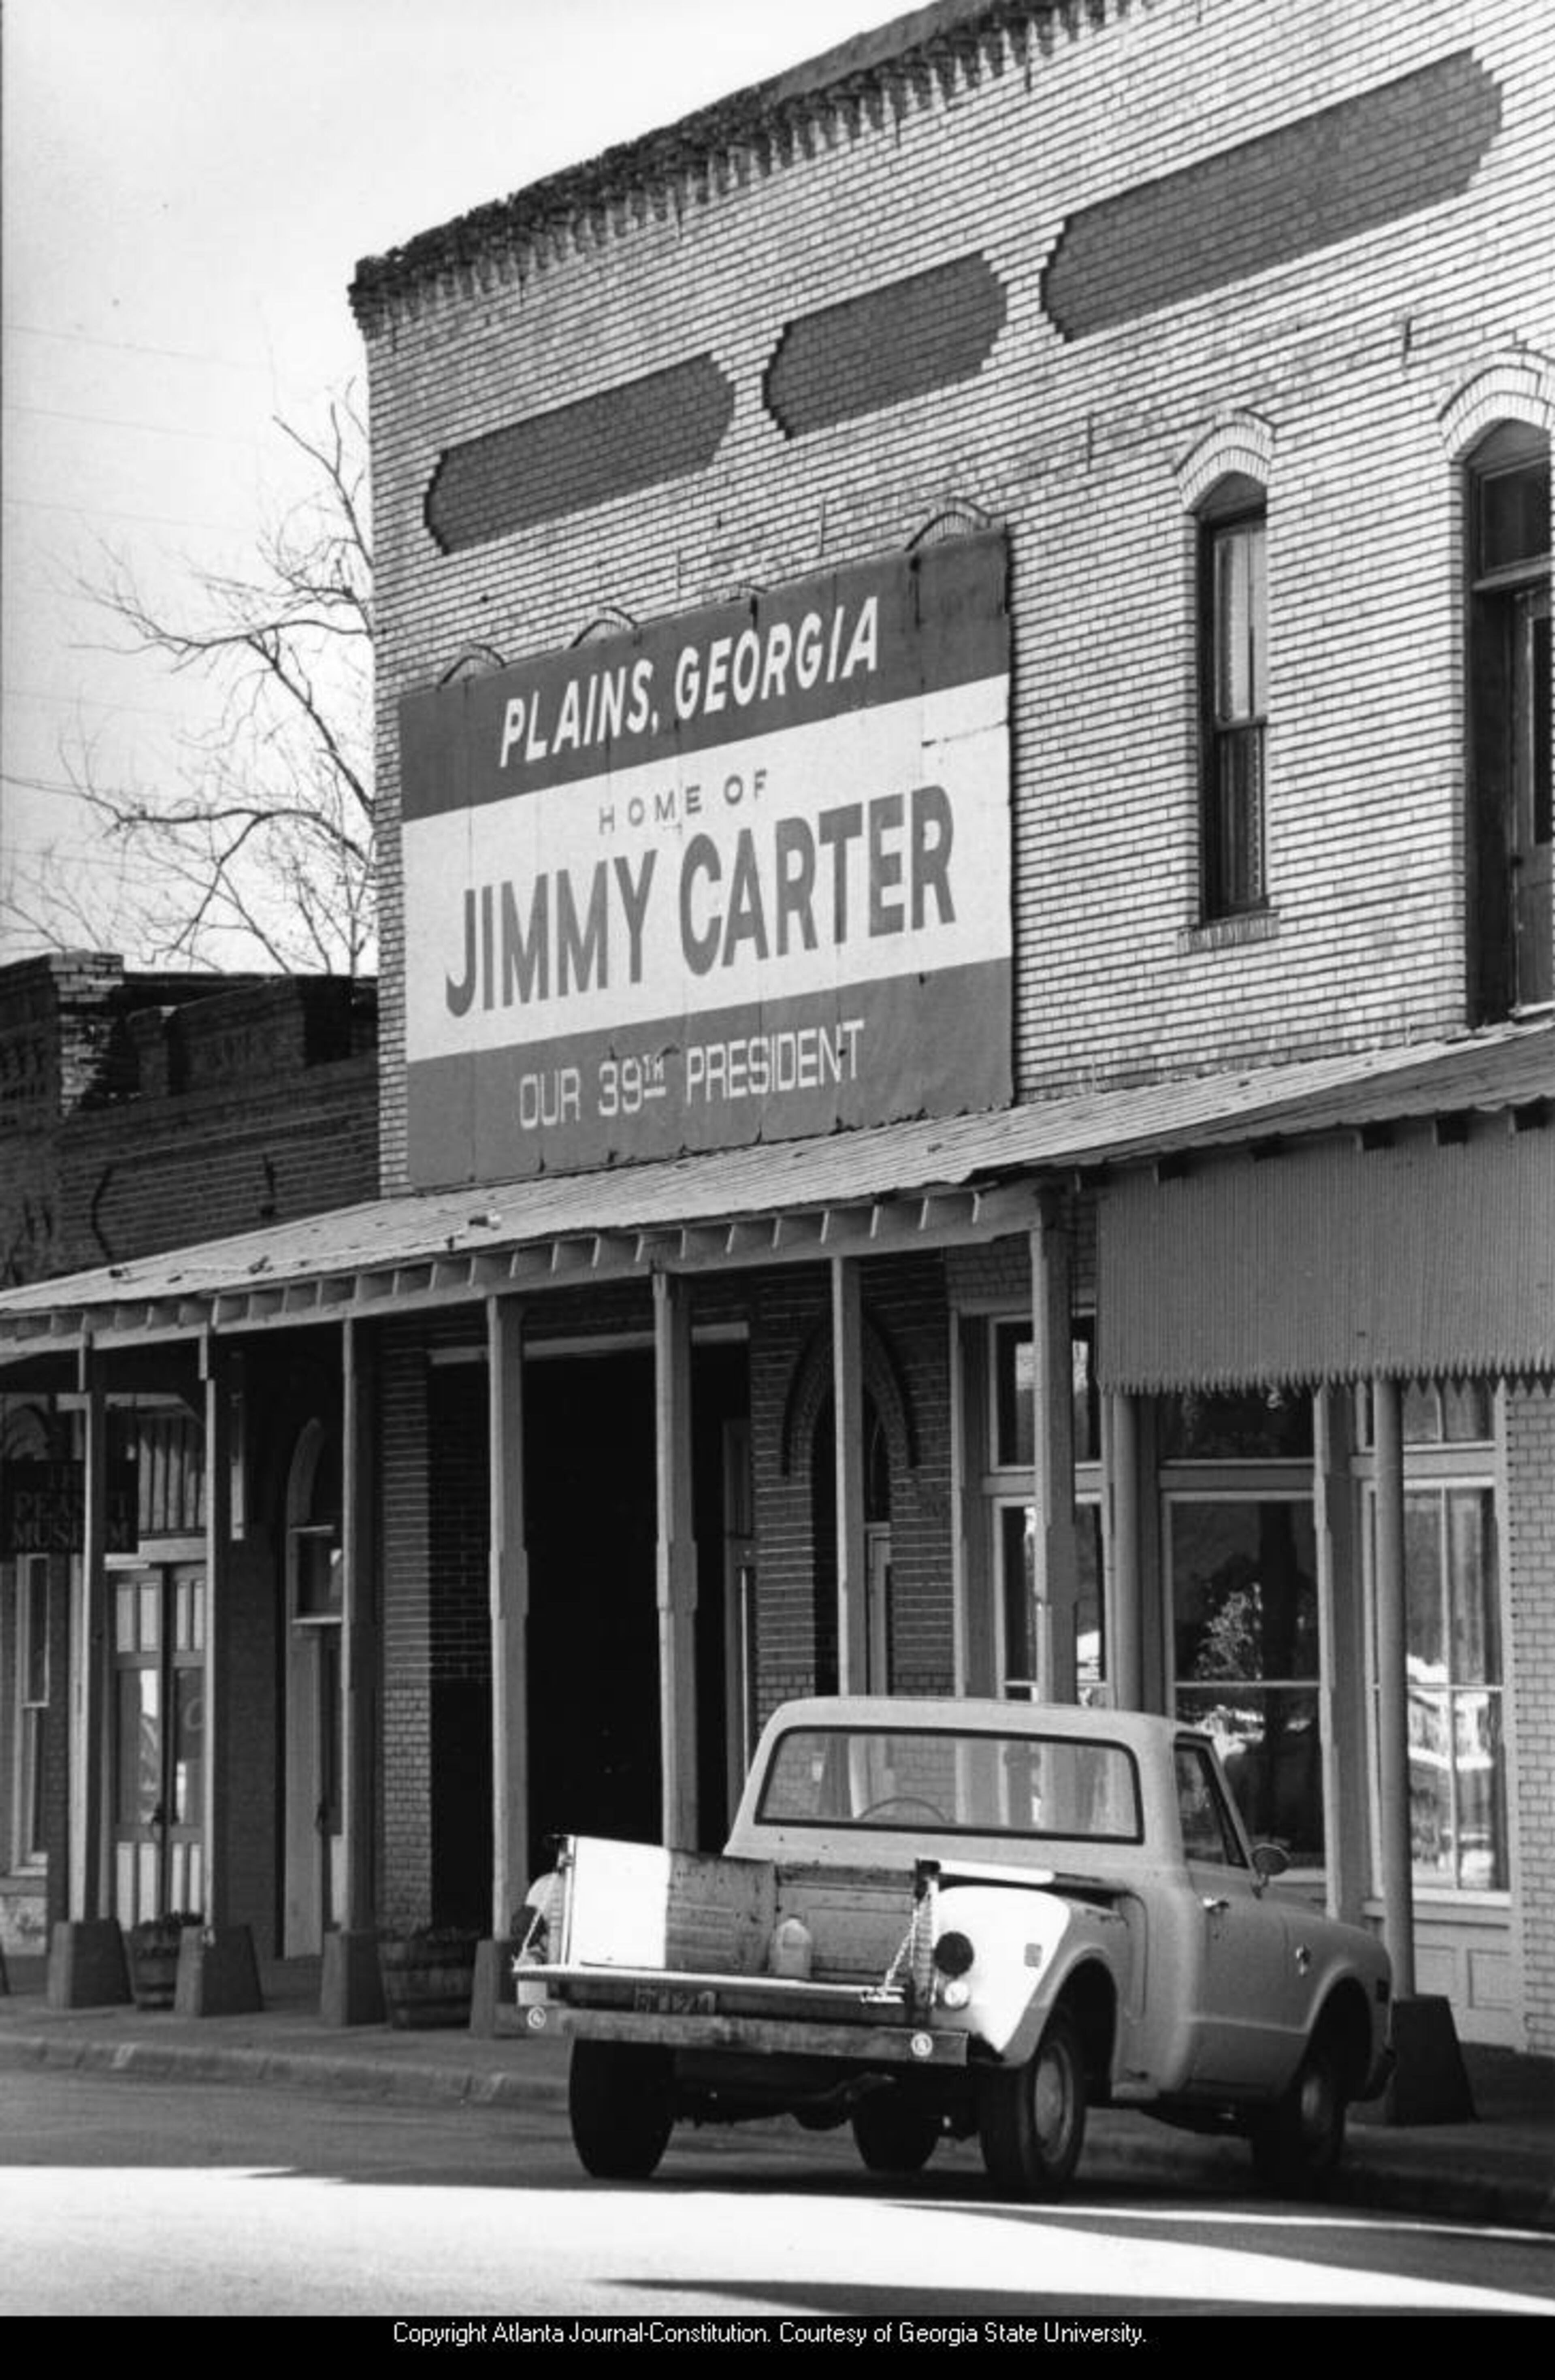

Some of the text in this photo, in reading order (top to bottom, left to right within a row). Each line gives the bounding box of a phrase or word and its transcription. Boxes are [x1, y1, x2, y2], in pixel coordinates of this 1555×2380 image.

[499, 597, 879, 768] PLAINS, GEORGIA
[599, 769, 768, 834] HOME OF
[445, 785, 956, 1018] JIMMY CARTER
[520, 1068, 581, 1130] OUR
[686, 1020, 865, 1106] PRESIDENT
